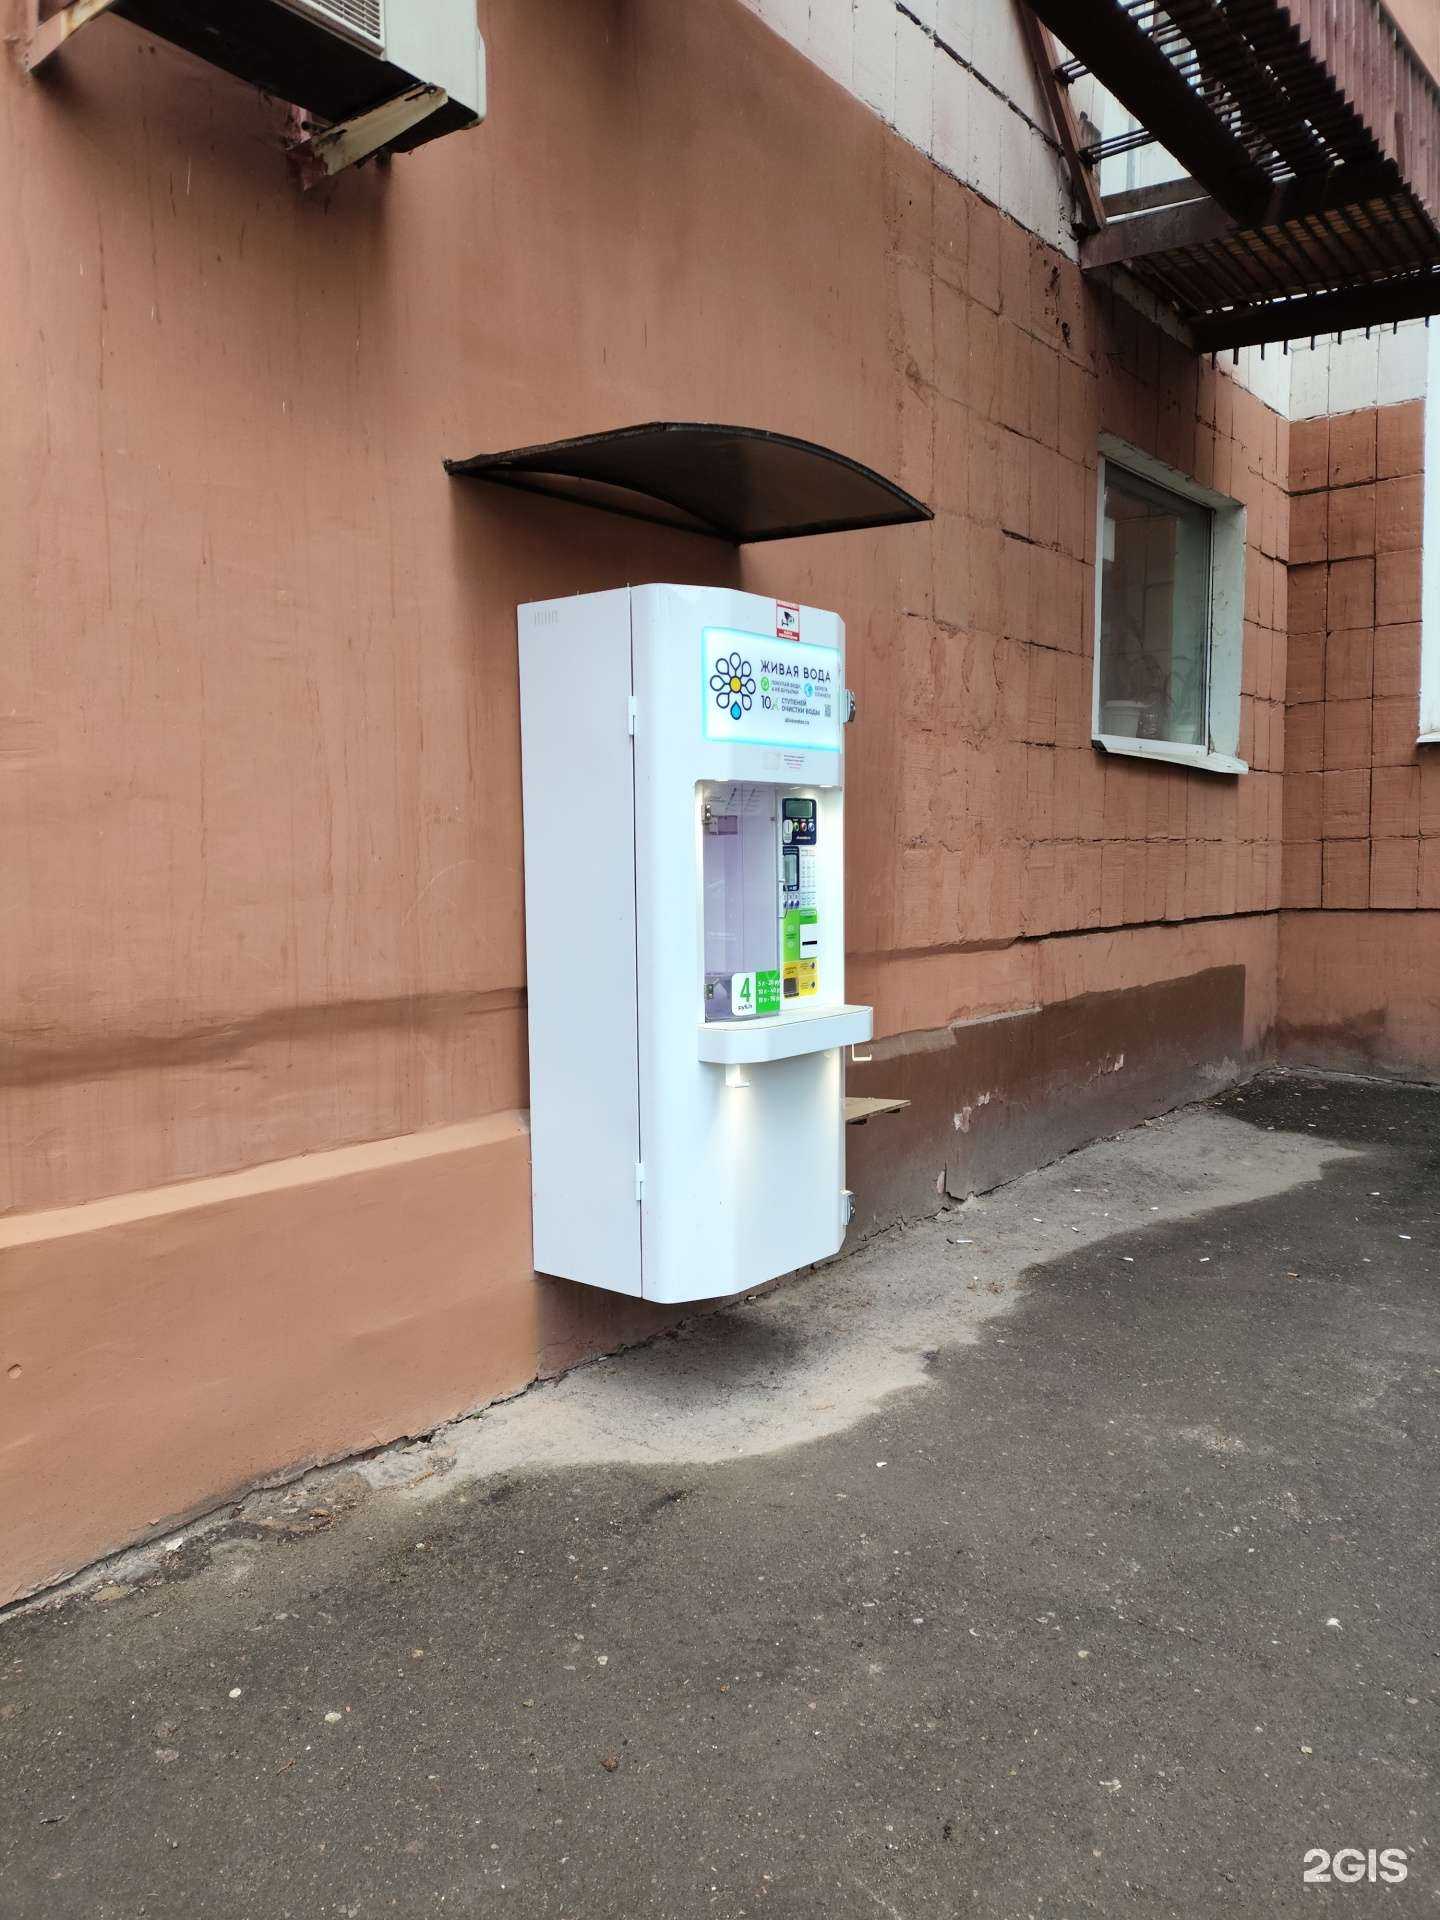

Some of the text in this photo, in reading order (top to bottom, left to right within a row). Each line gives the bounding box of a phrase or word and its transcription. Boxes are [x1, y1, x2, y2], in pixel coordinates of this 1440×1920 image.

[760, 659, 831, 683] ЖИВАЯ ВОДА
[760, 695, 772, 709] 10
[781, 697, 807, 706] СТУПЕНЕЙ
[781, 705, 805, 714] ОЧИСТКИ
[739, 977, 751, 1003] 4
